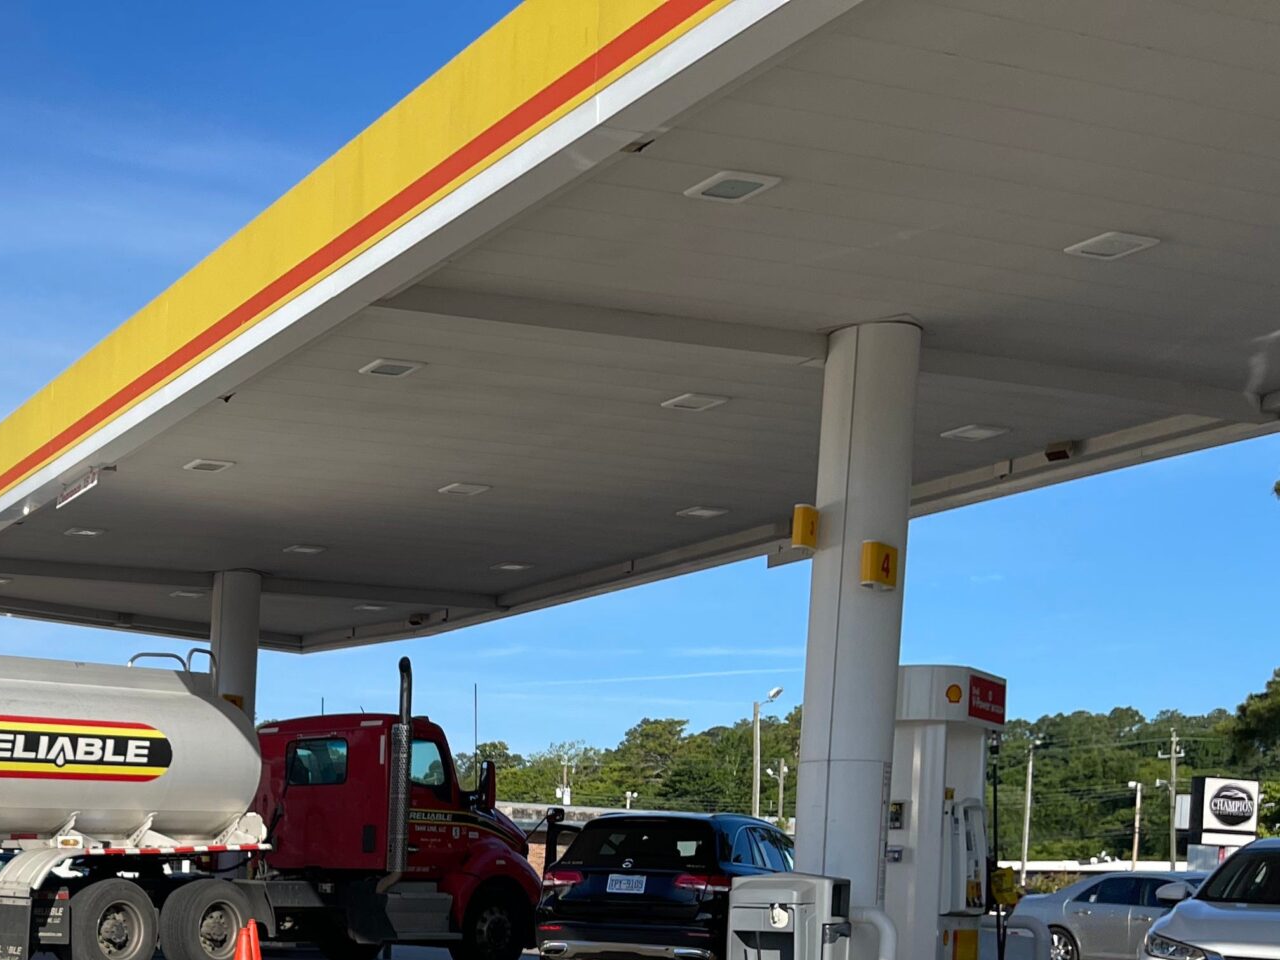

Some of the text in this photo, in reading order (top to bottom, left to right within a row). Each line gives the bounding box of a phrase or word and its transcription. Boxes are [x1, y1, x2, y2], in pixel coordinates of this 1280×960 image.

[880, 553, 891, 579] 4
[1211, 799, 1254, 812] CHAMPION
[409, 811, 453, 821] RELIABLE
